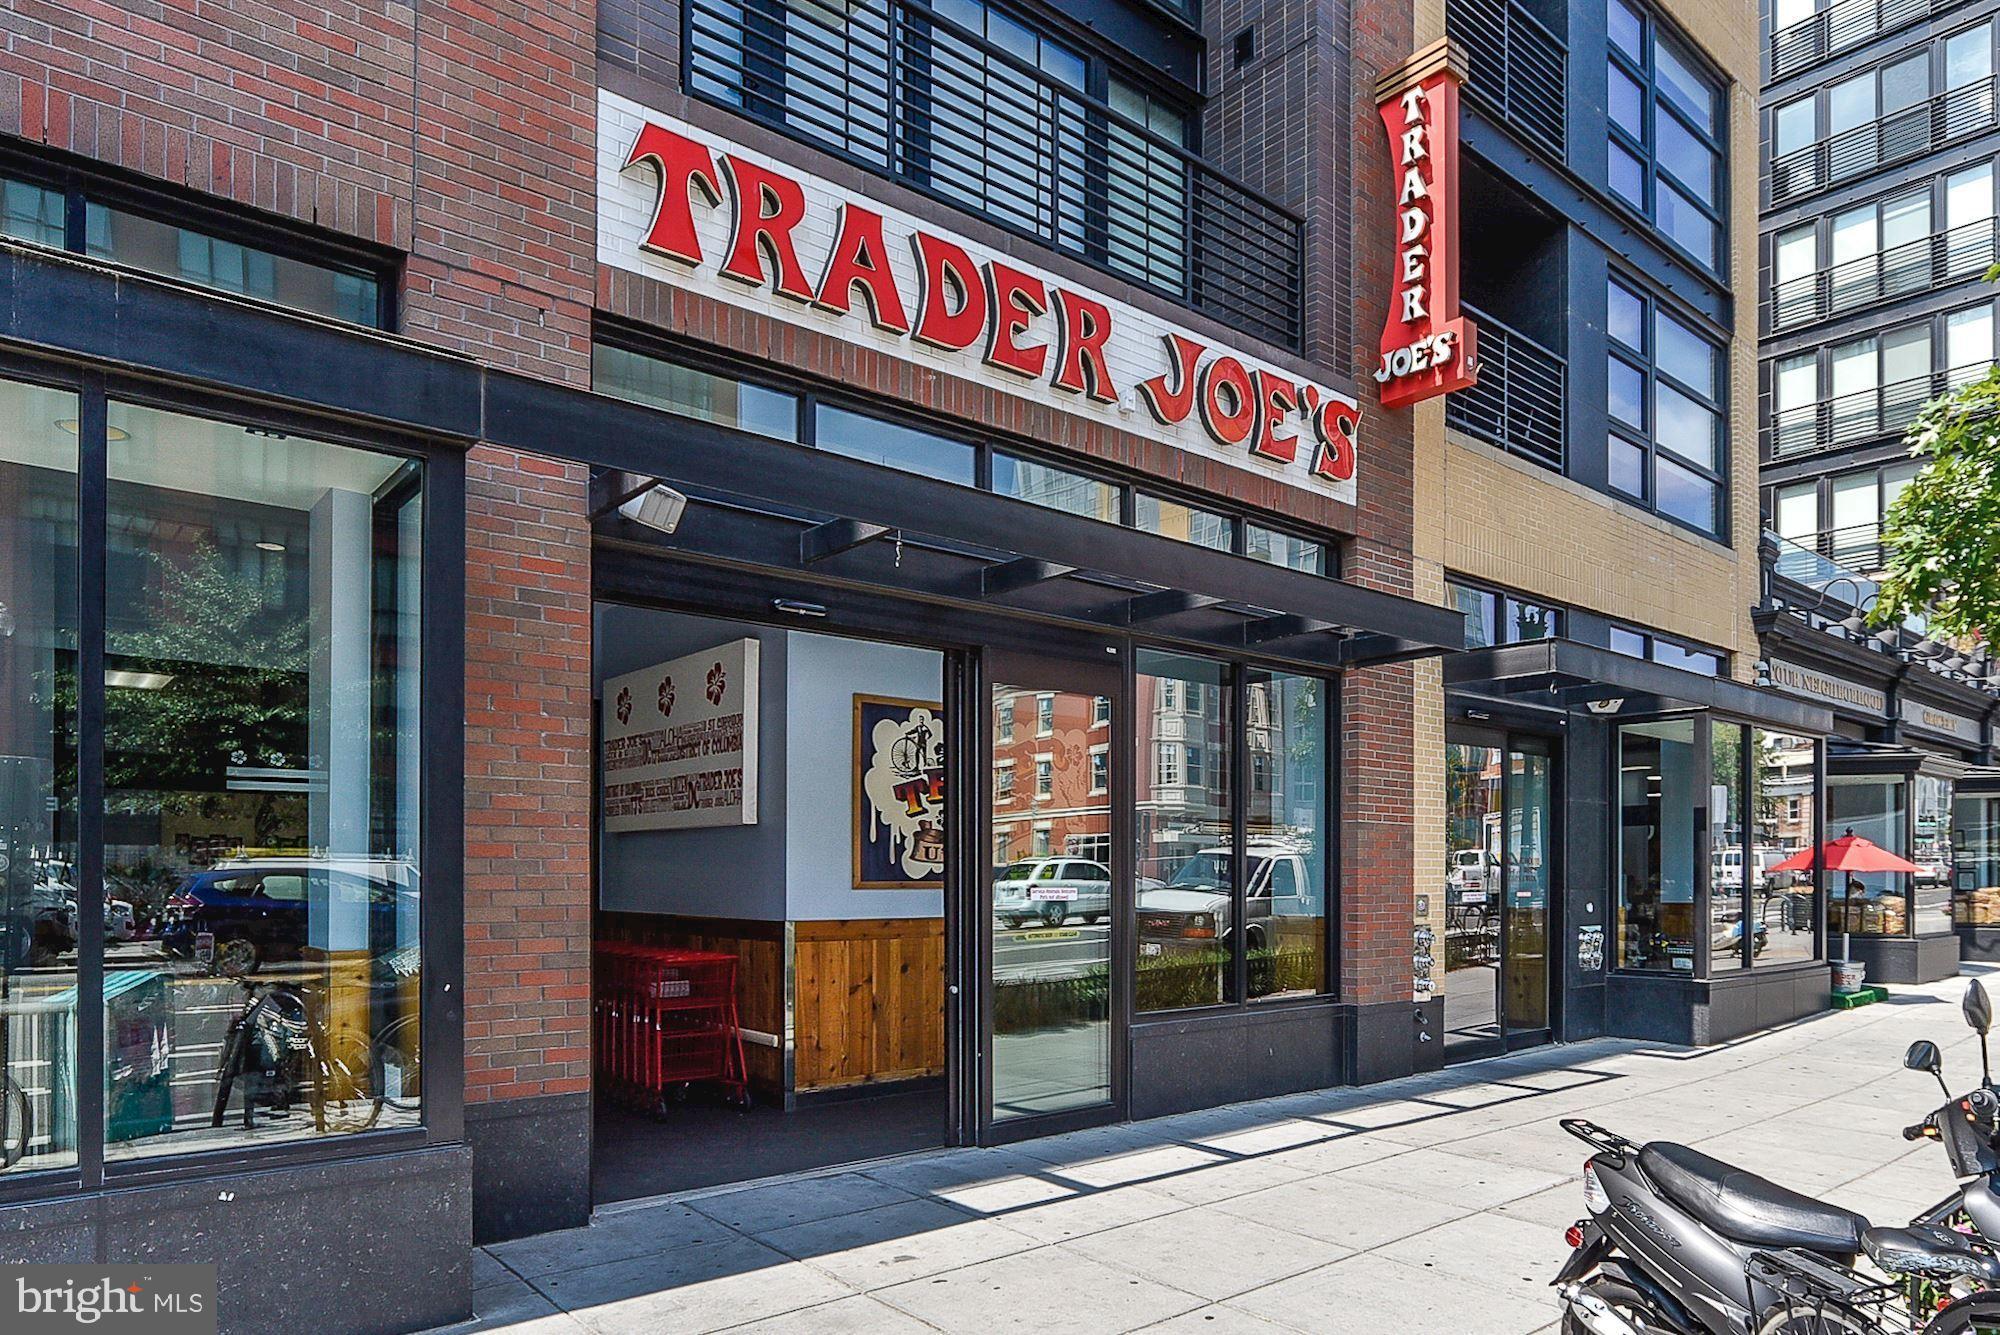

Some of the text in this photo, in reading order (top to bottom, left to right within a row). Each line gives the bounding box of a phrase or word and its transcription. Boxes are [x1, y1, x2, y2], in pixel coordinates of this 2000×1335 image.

[1399, 84, 1430, 323] TRADER
[620, 120, 1362, 482] TRADER JOE'S
[1373, 331, 1456, 383] JOE'S
[1772, 664, 1883, 711] YOUR NEIGHBORHOOD
